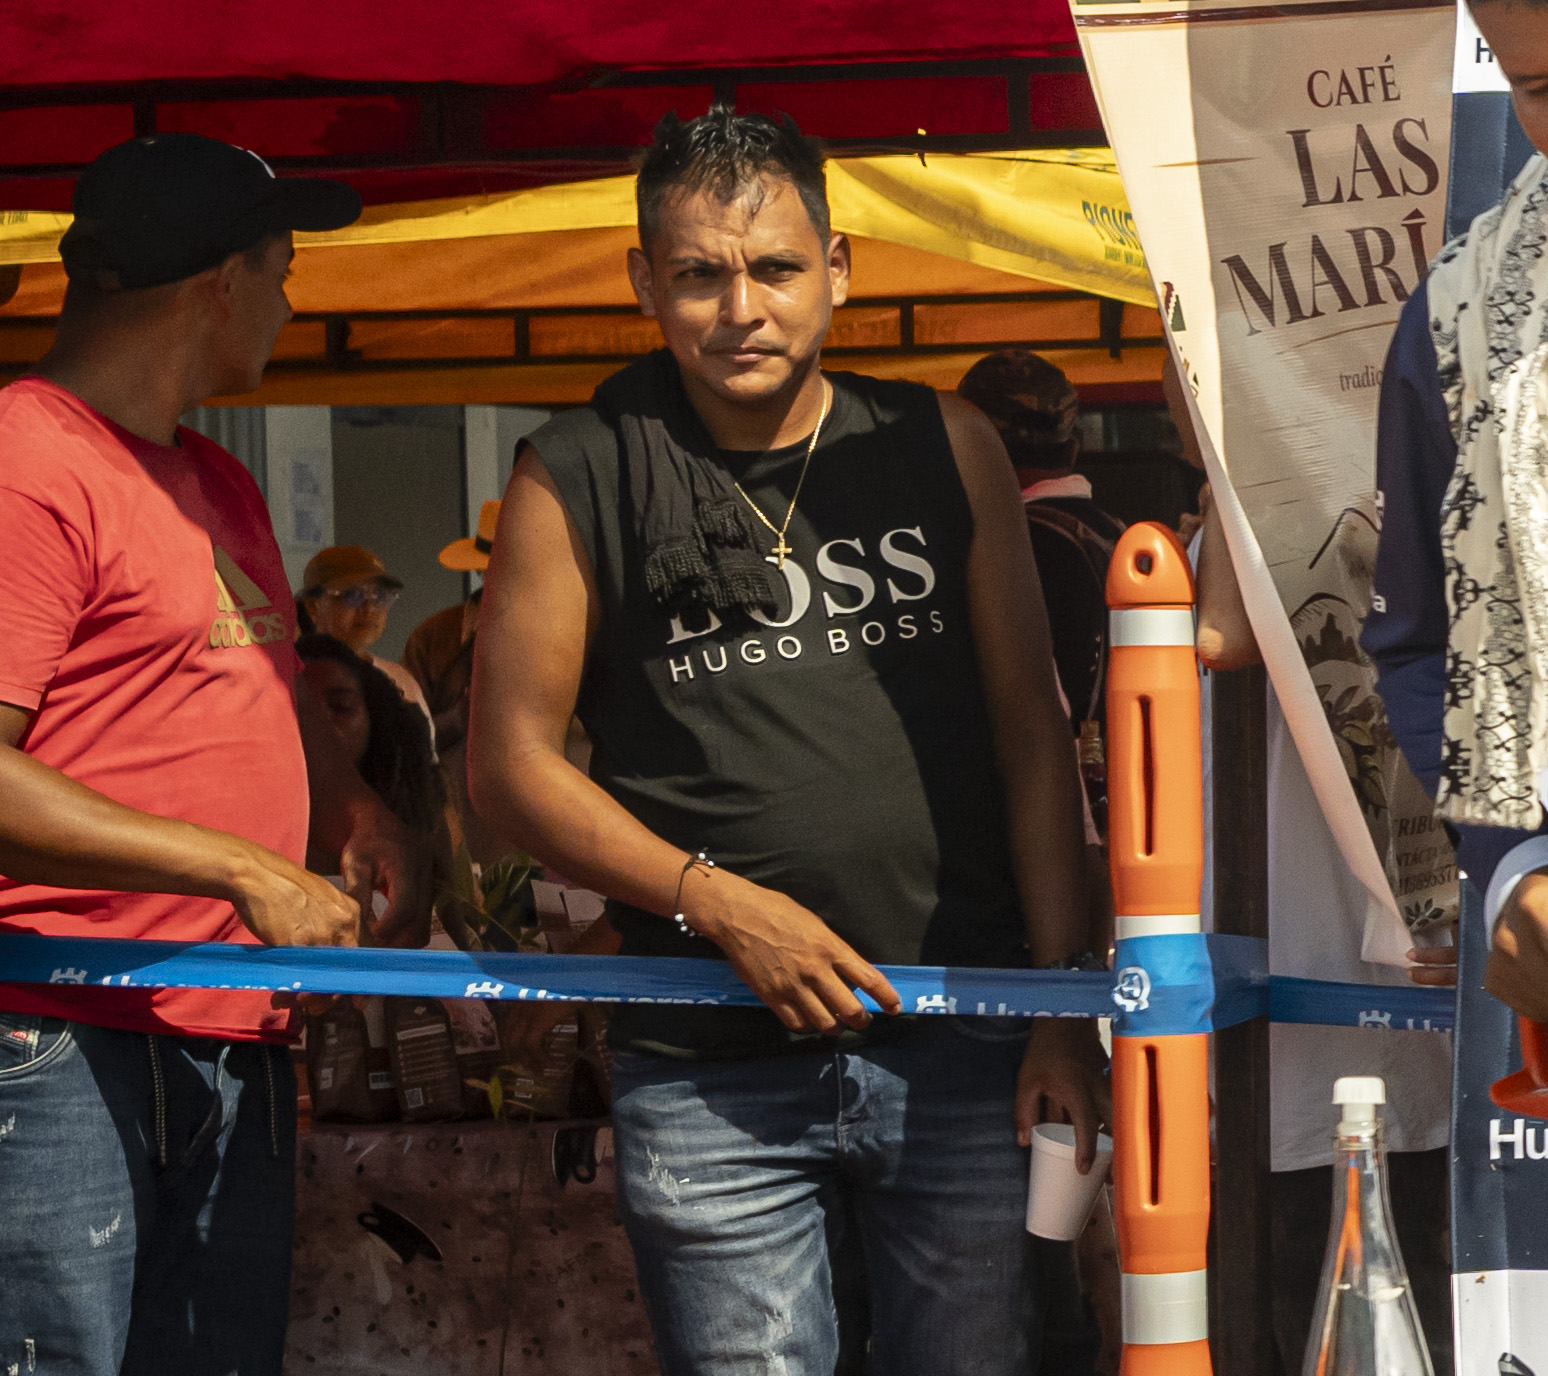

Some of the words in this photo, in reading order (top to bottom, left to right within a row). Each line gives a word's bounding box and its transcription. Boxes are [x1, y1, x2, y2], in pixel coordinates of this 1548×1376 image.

[1306, 54, 1401, 109] CAFÉ
[1286, 117, 1440, 209] LAS
[209, 611, 288, 649] adidas
[668, 635, 802, 683] HUGO
[826, 610, 944, 655] BOSS
